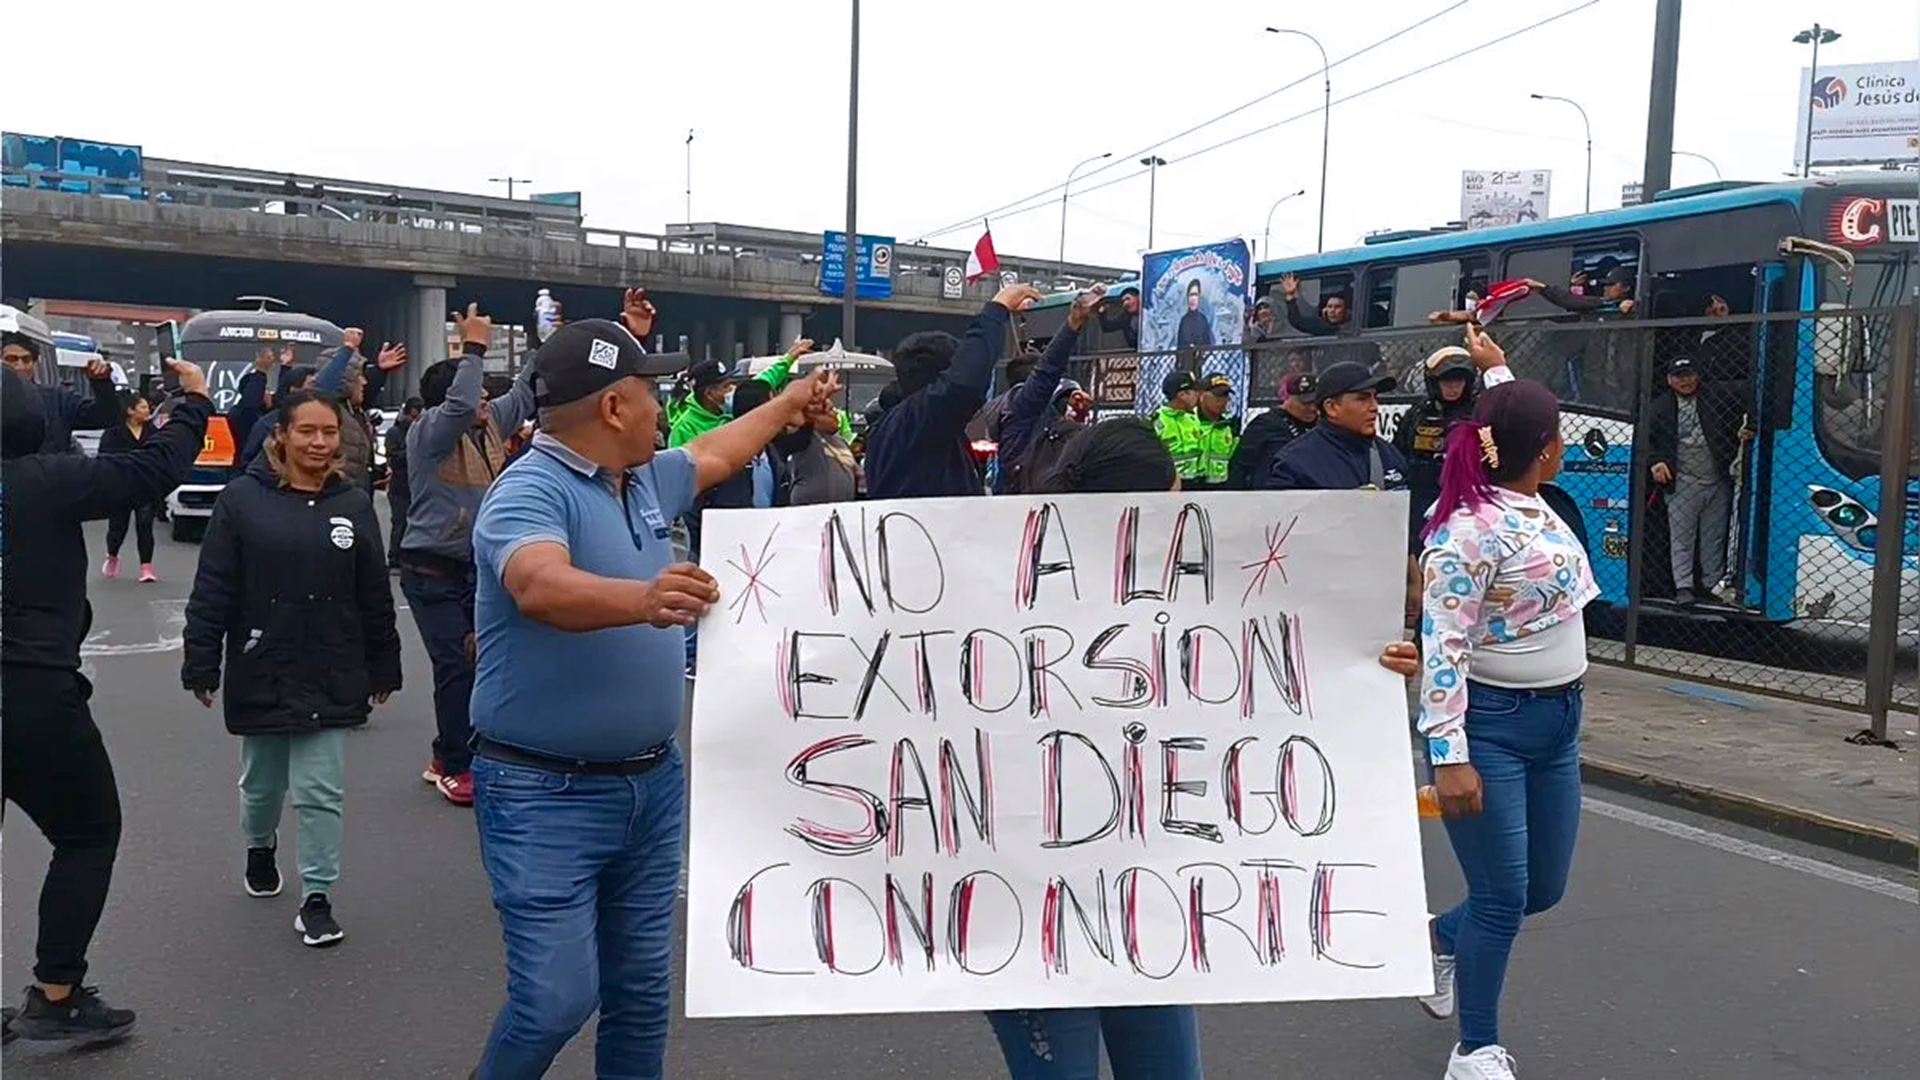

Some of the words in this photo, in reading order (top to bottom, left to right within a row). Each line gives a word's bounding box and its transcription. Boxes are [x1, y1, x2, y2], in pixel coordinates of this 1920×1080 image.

[819, 504, 944, 617] NO
[1014, 502, 1080, 612] A
[1113, 502, 1214, 606] LA
[783, 728, 997, 859] SAN
[726, 863, 1024, 976] CONO
[1041, 858, 1388, 980] NORTE
